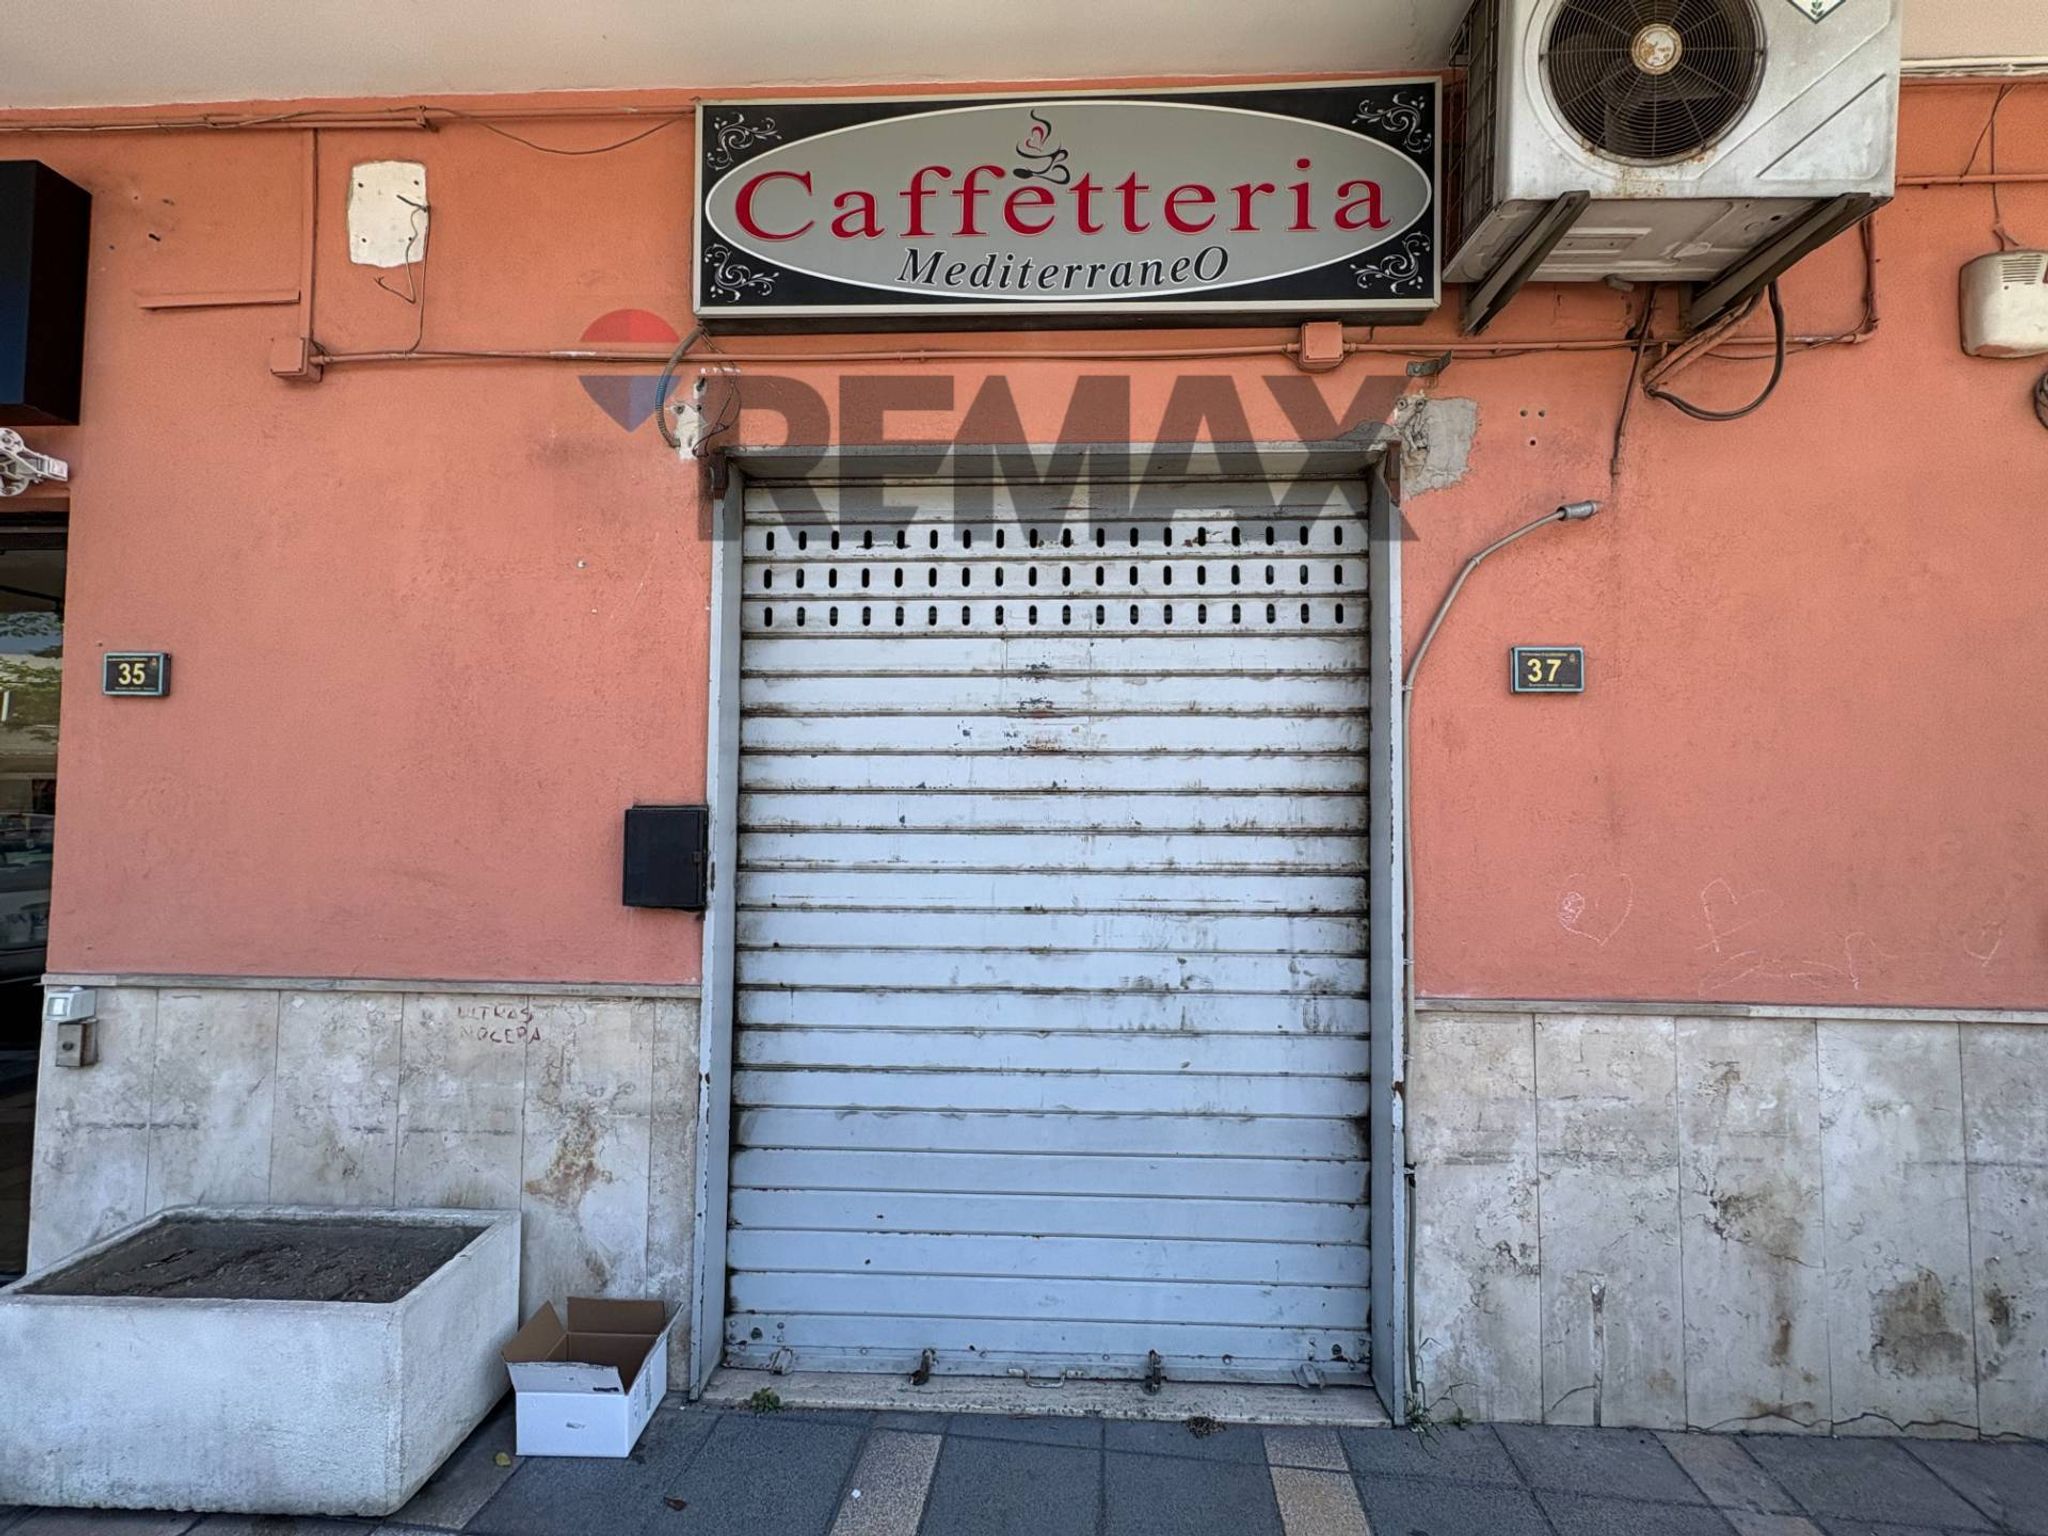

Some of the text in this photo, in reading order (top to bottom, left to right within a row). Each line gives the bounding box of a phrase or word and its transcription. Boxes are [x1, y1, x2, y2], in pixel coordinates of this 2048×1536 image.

[734, 158, 1392, 242] Caffetteria
[118, 662, 145, 685] 35
[1527, 658, 1562, 682] 37
